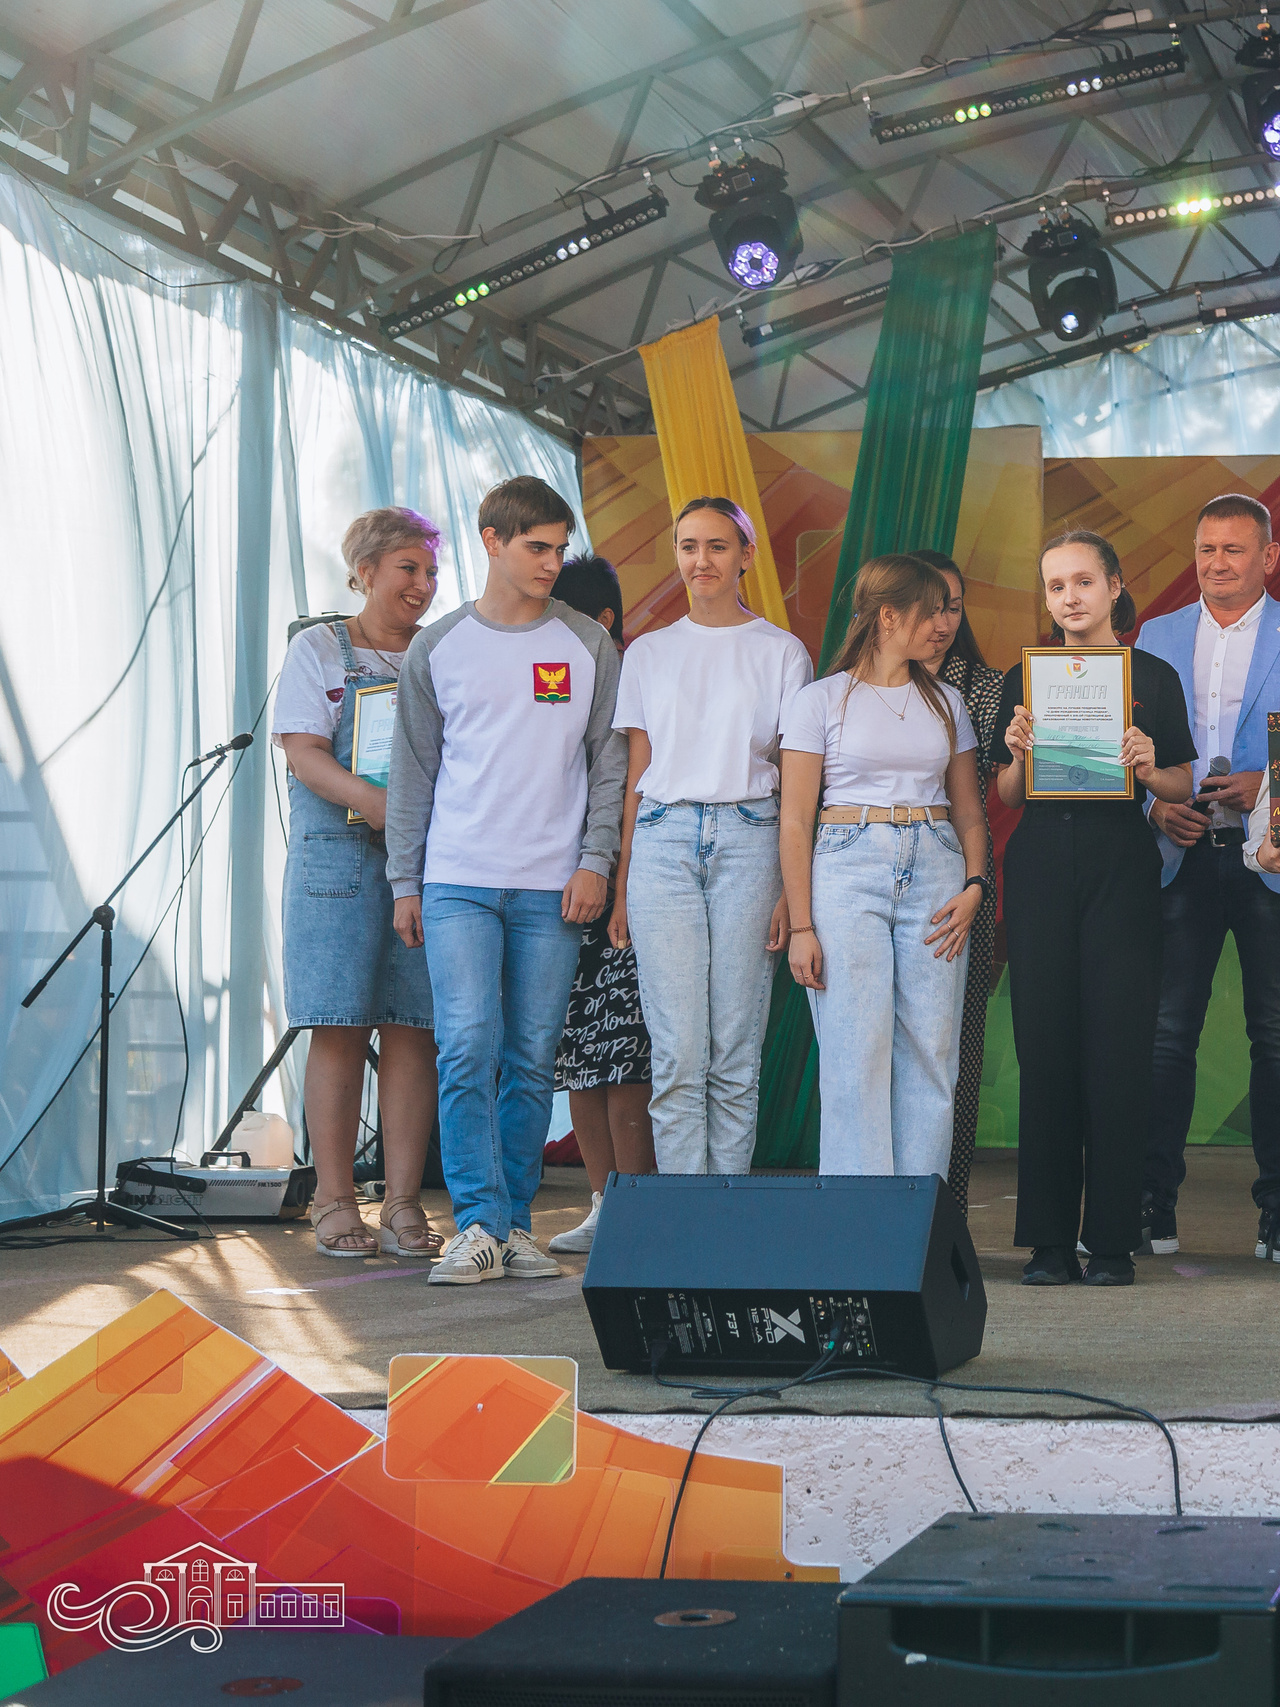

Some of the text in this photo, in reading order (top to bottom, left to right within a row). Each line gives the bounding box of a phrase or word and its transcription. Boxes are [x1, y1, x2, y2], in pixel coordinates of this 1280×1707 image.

[1047, 685, 1108, 699] ГРАМОТА
[725, 1312, 740, 1338] FBT
[761, 1307, 774, 1344] PRO
